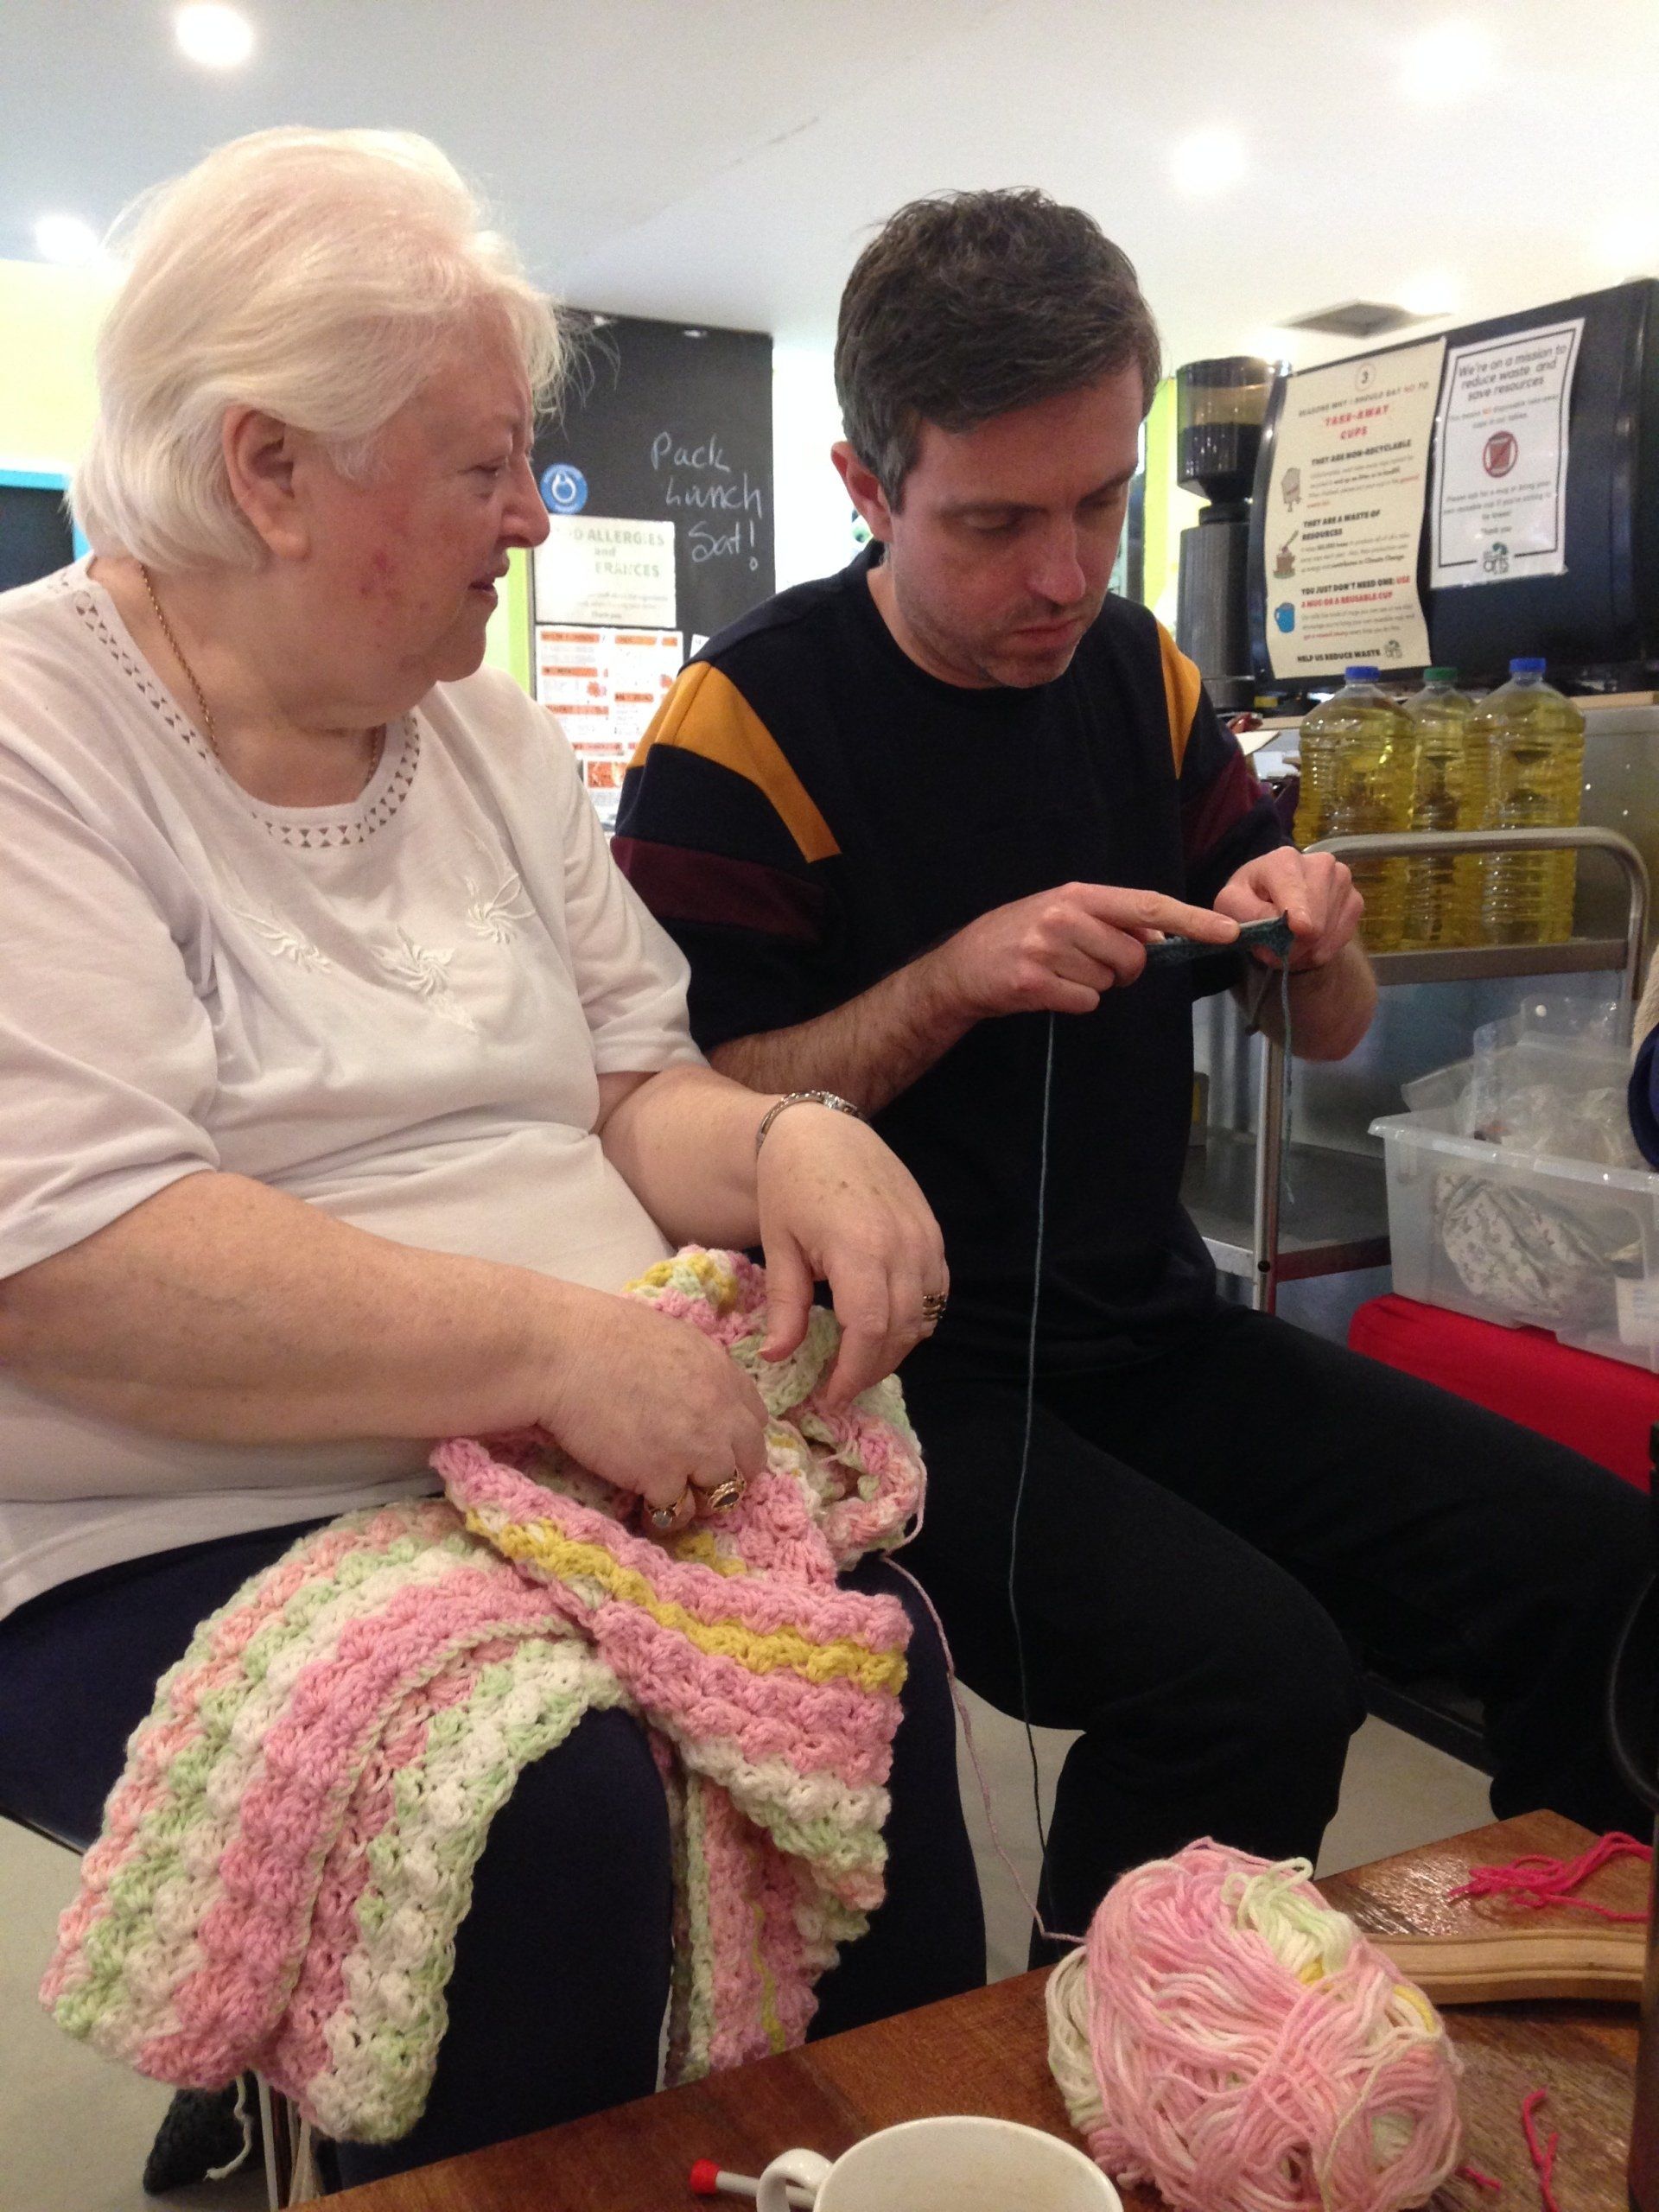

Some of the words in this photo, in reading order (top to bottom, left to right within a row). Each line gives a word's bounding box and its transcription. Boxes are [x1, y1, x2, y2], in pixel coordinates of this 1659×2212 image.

[1459, 362, 1488, 377] We're
[1491, 359, 1503, 371] on
[1505, 357, 1512, 366] a
[1515, 347, 1554, 364] mission
[1555, 345, 1567, 355] to
[1361, 371, 1370, 385] 3
[1461, 373, 1497, 389] reduce
[1499, 365, 1531, 380] waste
[1535, 356, 1557, 372] and
[1468, 388, 1492, 401] save
[1494, 377, 1545, 395] resources
[1325, 404, 1390, 427] TAKE-AWAY
[1340, 426, 1369, 440] CUPS
[651, 431, 731, 473] Pack
[1312, 456, 1329, 466] THEY
[1331, 453, 1344, 462] ARE
[665, 473, 763, 518] Lunch
[1303, 518, 1321, 528] THEY
[1322, 516, 1337, 525] ARE
[1344, 511, 1369, 522] WASTE
[1370, 509, 1381, 518] OF
[1302, 528, 1343, 541] RESOURCES
[688, 520, 759, 571] Sat!
[1316, 585, 1333, 594] JUST
[1333, 582, 1356, 592] DON'T
[1357, 580, 1376, 588] NEED
[1395, 575, 1410, 584] USE
[1297, 654, 1314, 663] HELP
[1315, 653, 1325, 662] US
[1325, 651, 1353, 661] REDUCE
[1354, 649, 1381, 658] WASTE
